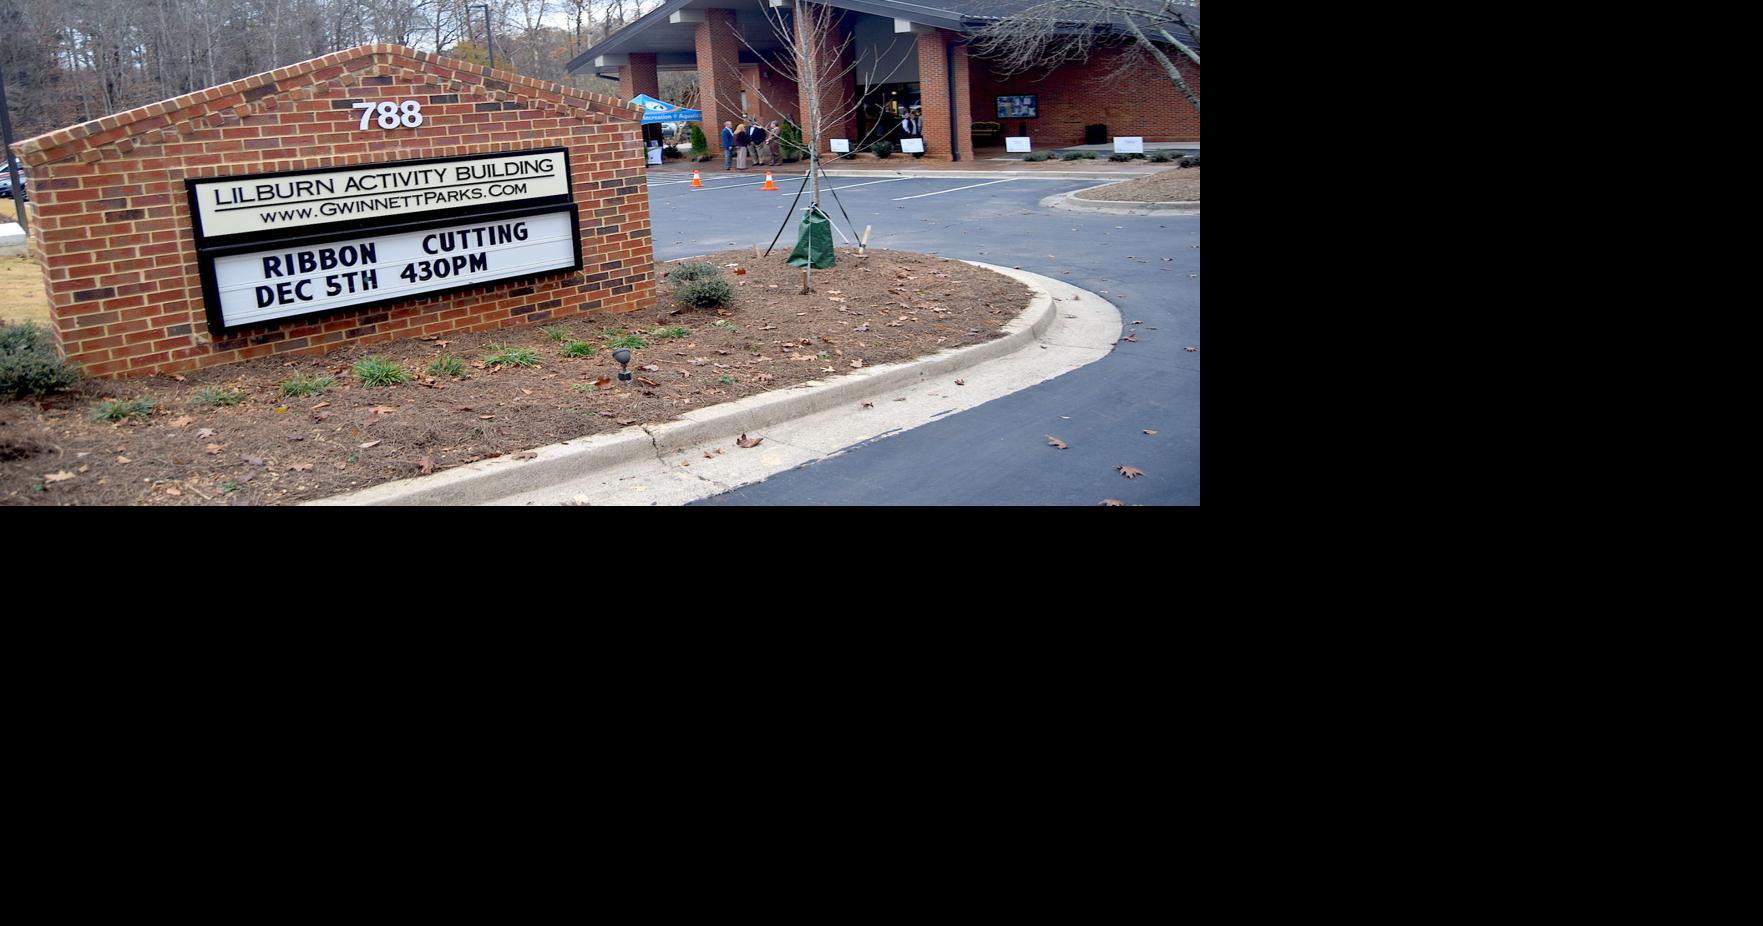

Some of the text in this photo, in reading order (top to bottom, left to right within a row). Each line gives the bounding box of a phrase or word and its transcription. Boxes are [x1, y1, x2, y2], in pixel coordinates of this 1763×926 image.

[352, 100, 424, 131] 788
[214, 158, 554, 206] LILBURN ACTIVITY BUILDING
[262, 222, 529, 279] RIBBON CUTTING
[255, 252, 488, 309] DEC 5TH 430PM
